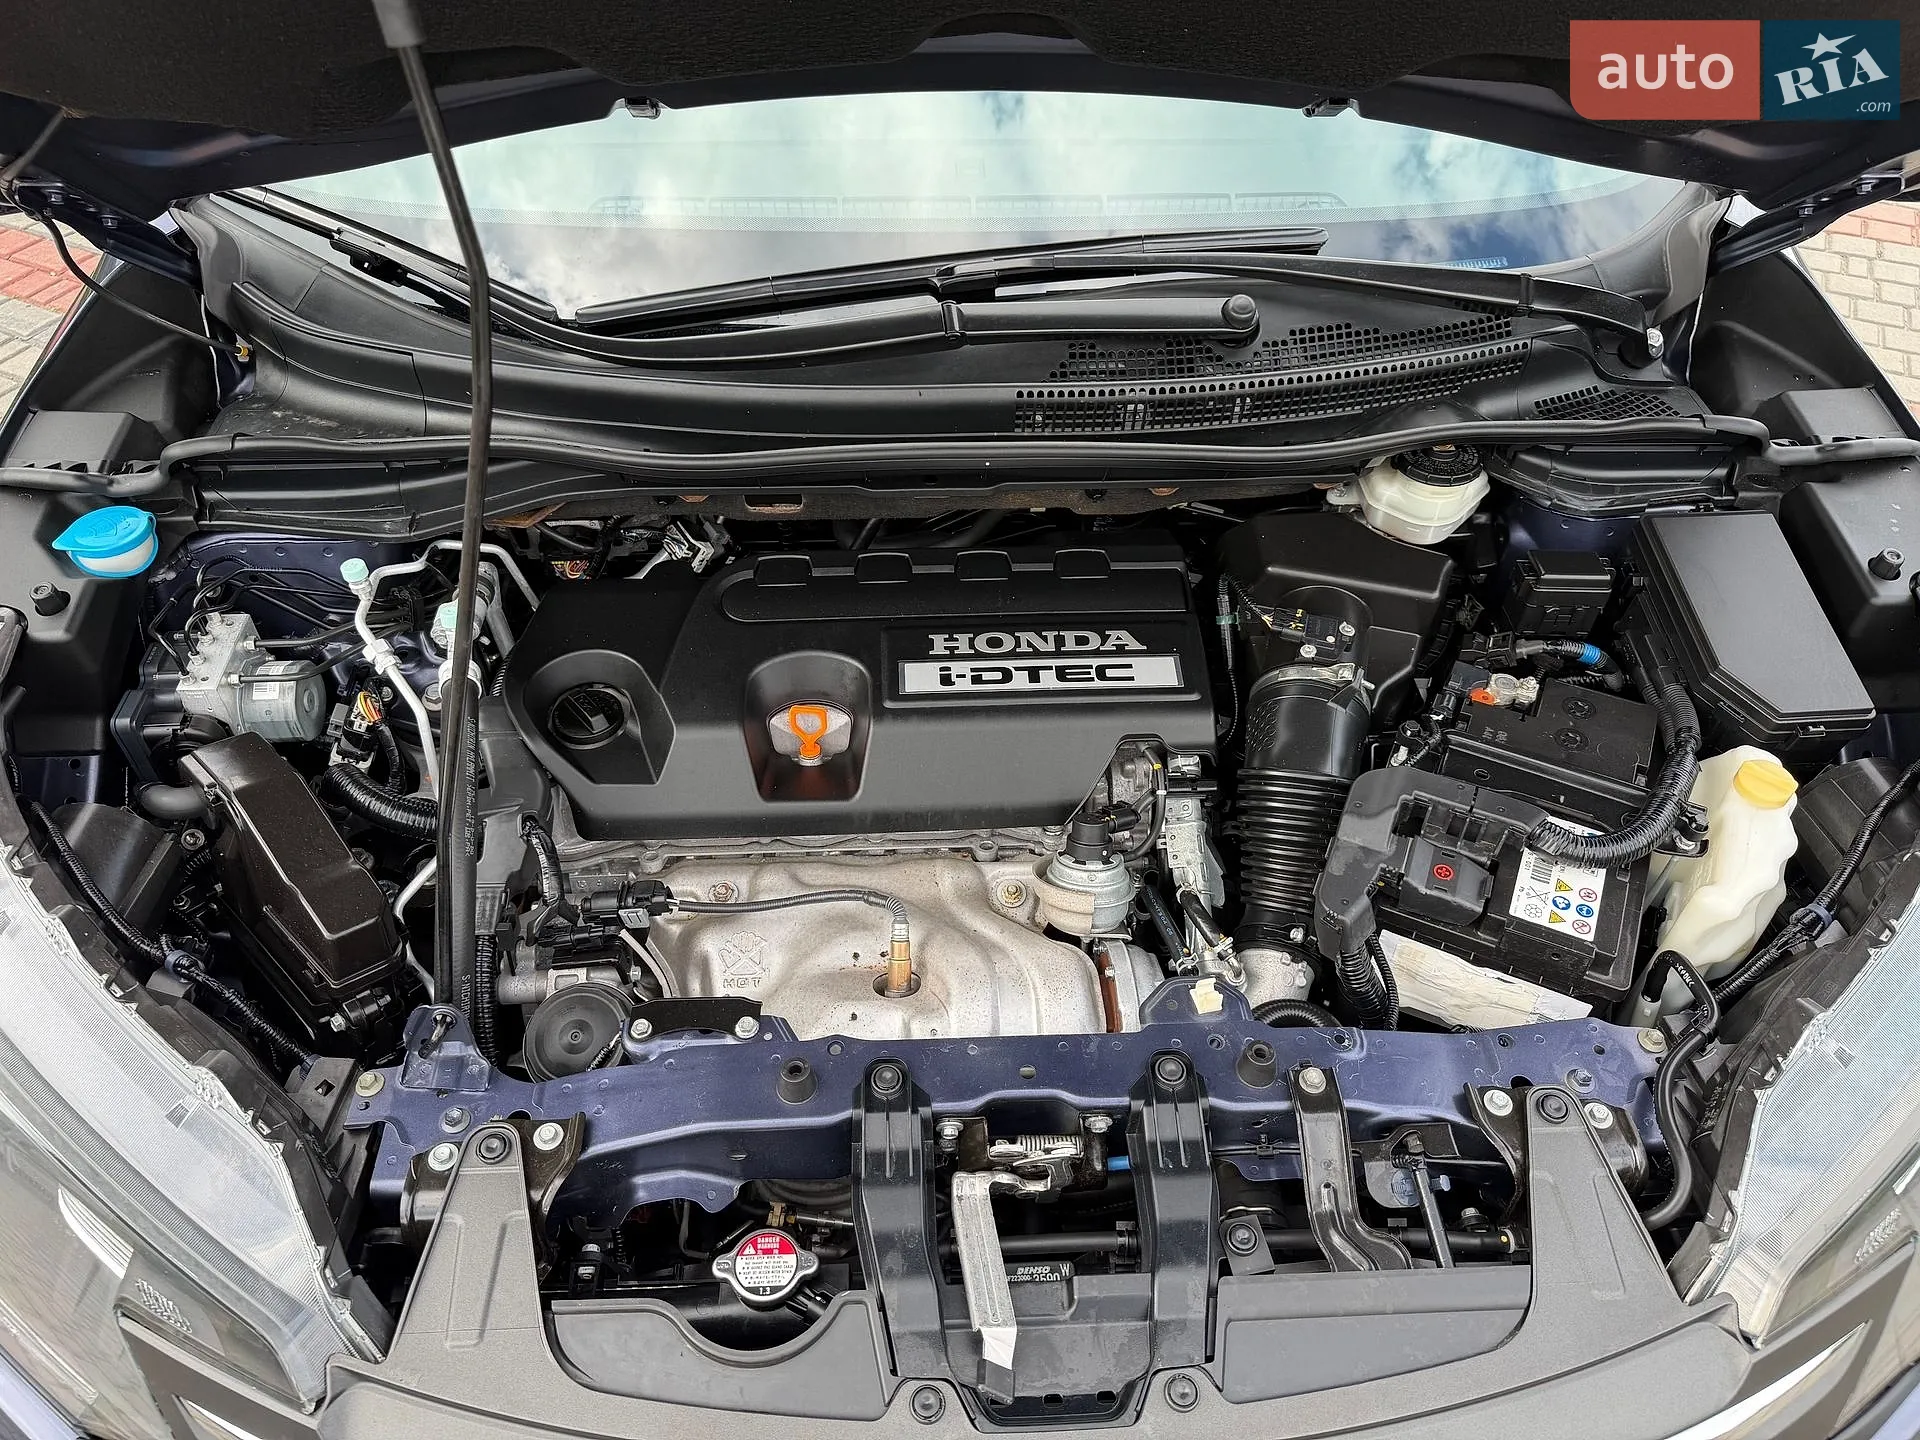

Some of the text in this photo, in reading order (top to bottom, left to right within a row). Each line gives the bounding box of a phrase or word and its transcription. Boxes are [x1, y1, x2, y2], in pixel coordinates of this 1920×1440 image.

[929, 630, 1148, 655] HONDA
[938, 664, 1135, 687] i-DTEC
[1016, 1265, 1051, 1275] DENSO
